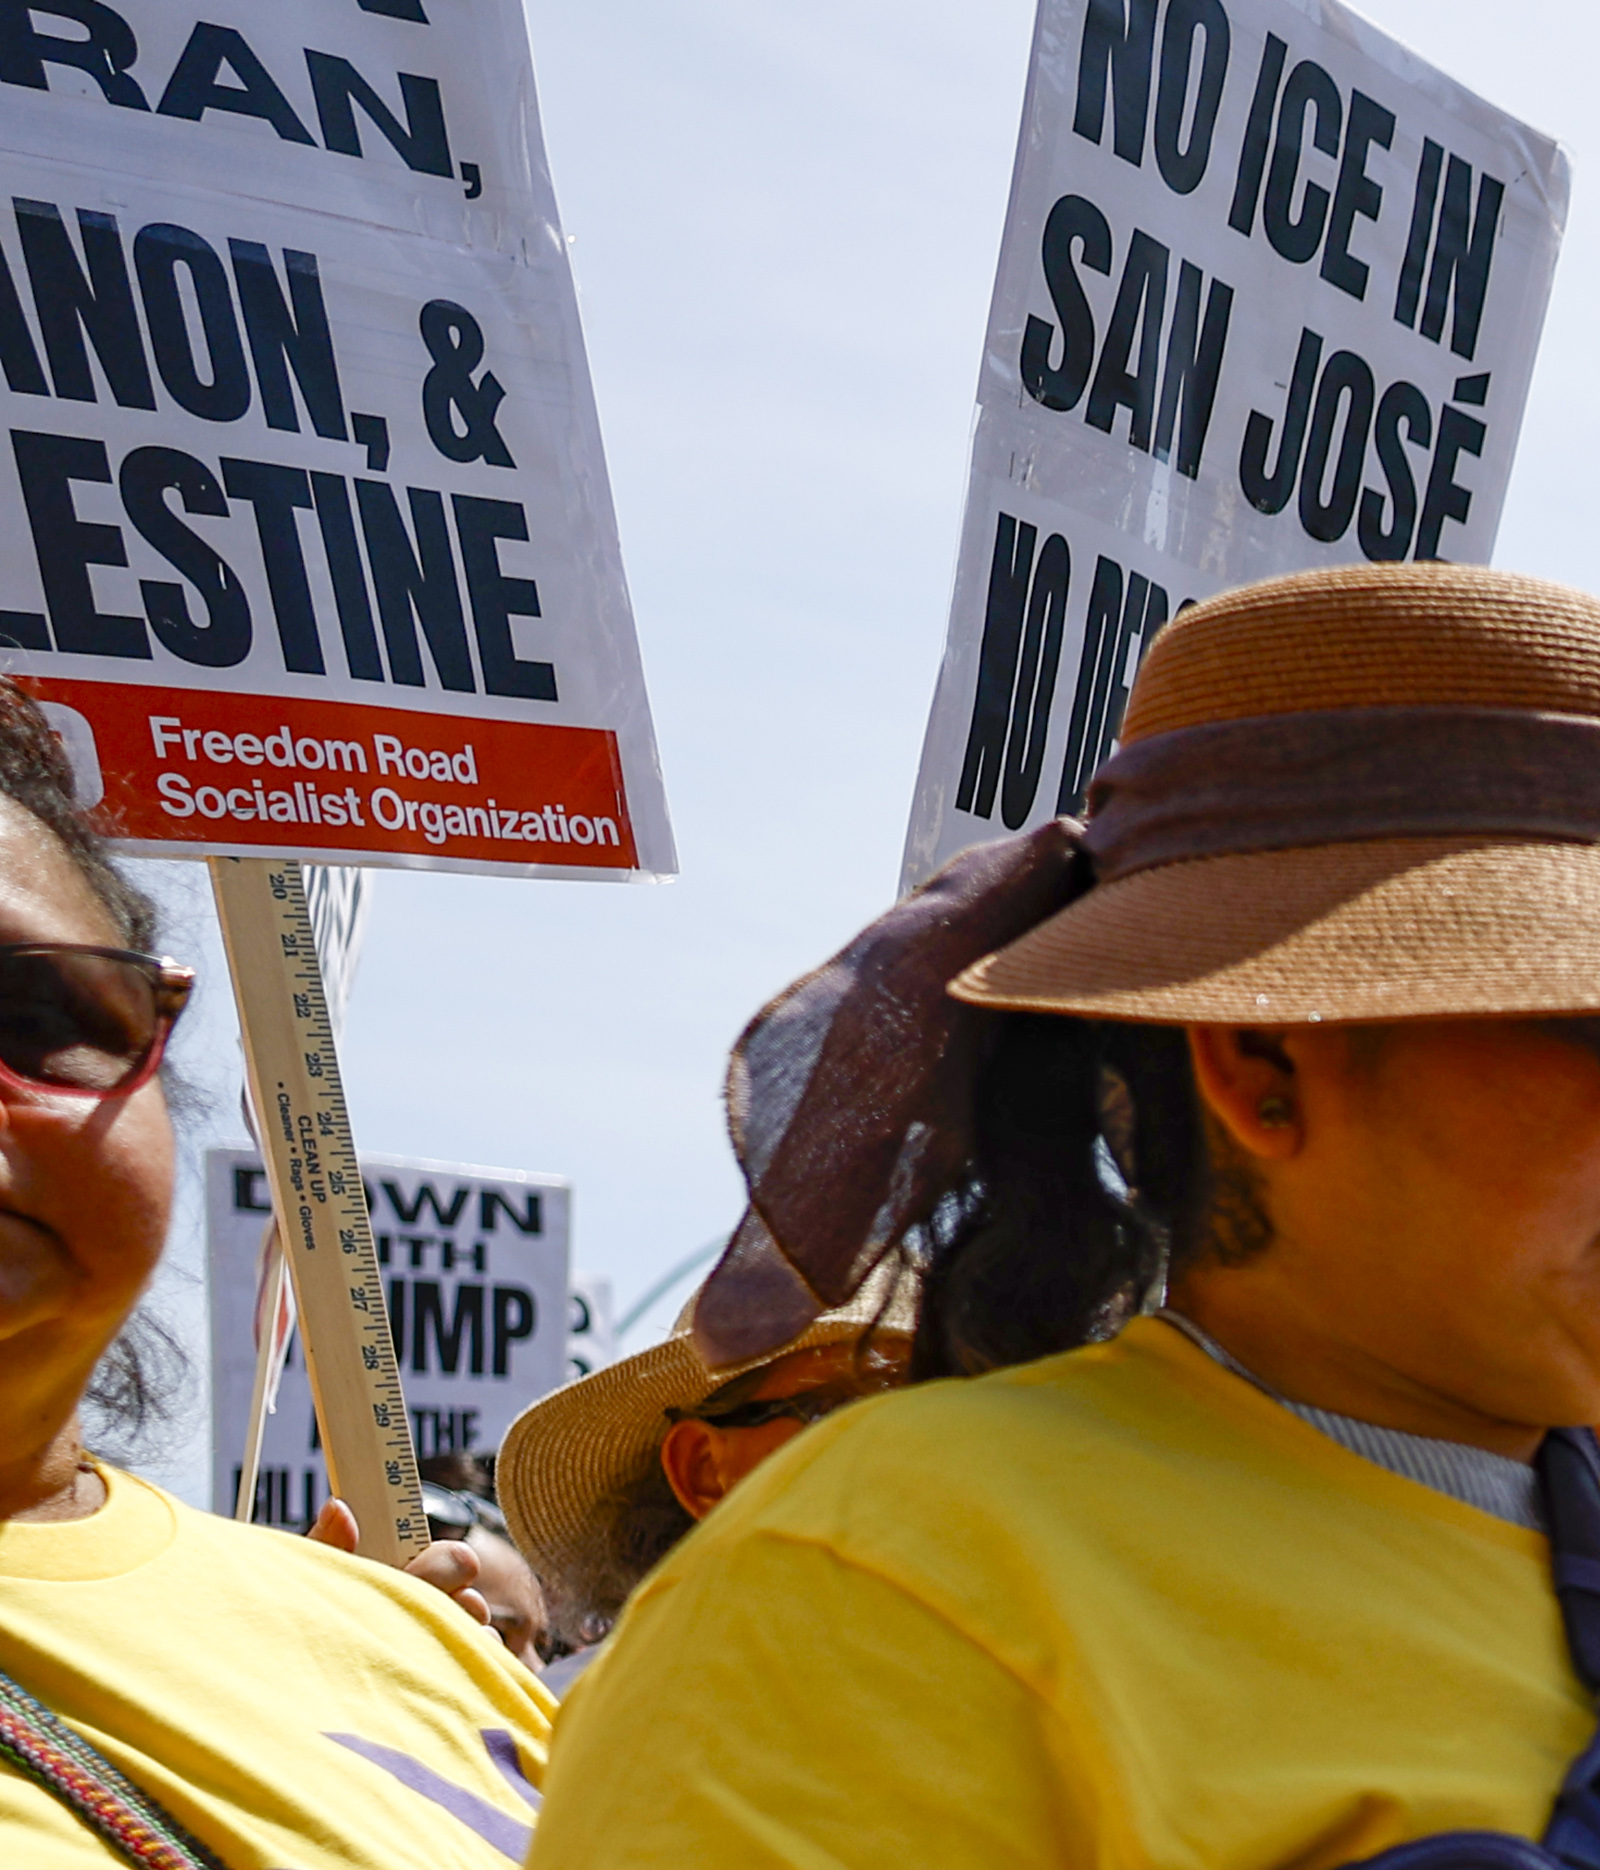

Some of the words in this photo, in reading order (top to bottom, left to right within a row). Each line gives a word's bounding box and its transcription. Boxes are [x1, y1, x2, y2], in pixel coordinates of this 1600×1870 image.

[1072, 0, 1230, 196] NO
[1227, 30, 1396, 302] ICE
[1393, 135, 1506, 362] IN
[418, 298, 517, 470] &
[1019, 194, 1235, 482] SAN
[1238, 326, 1490, 563] JOSÉ
[0, 428, 558, 702] ESTINE
[148, 714, 368, 775] Freedom
[376, 733, 478, 786] Road
[955, 512, 1071, 831] NO
[158, 772, 364, 828] Socialist
[369, 784, 620, 848] Organization
[277, 1093, 296, 1143] Cleaner
[290, 1158, 304, 1191] Rags
[300, 1206, 316, 1251] Gloves
[298, 1115, 322, 1174] CLEAN
[310, 1179, 326, 1204] UP
